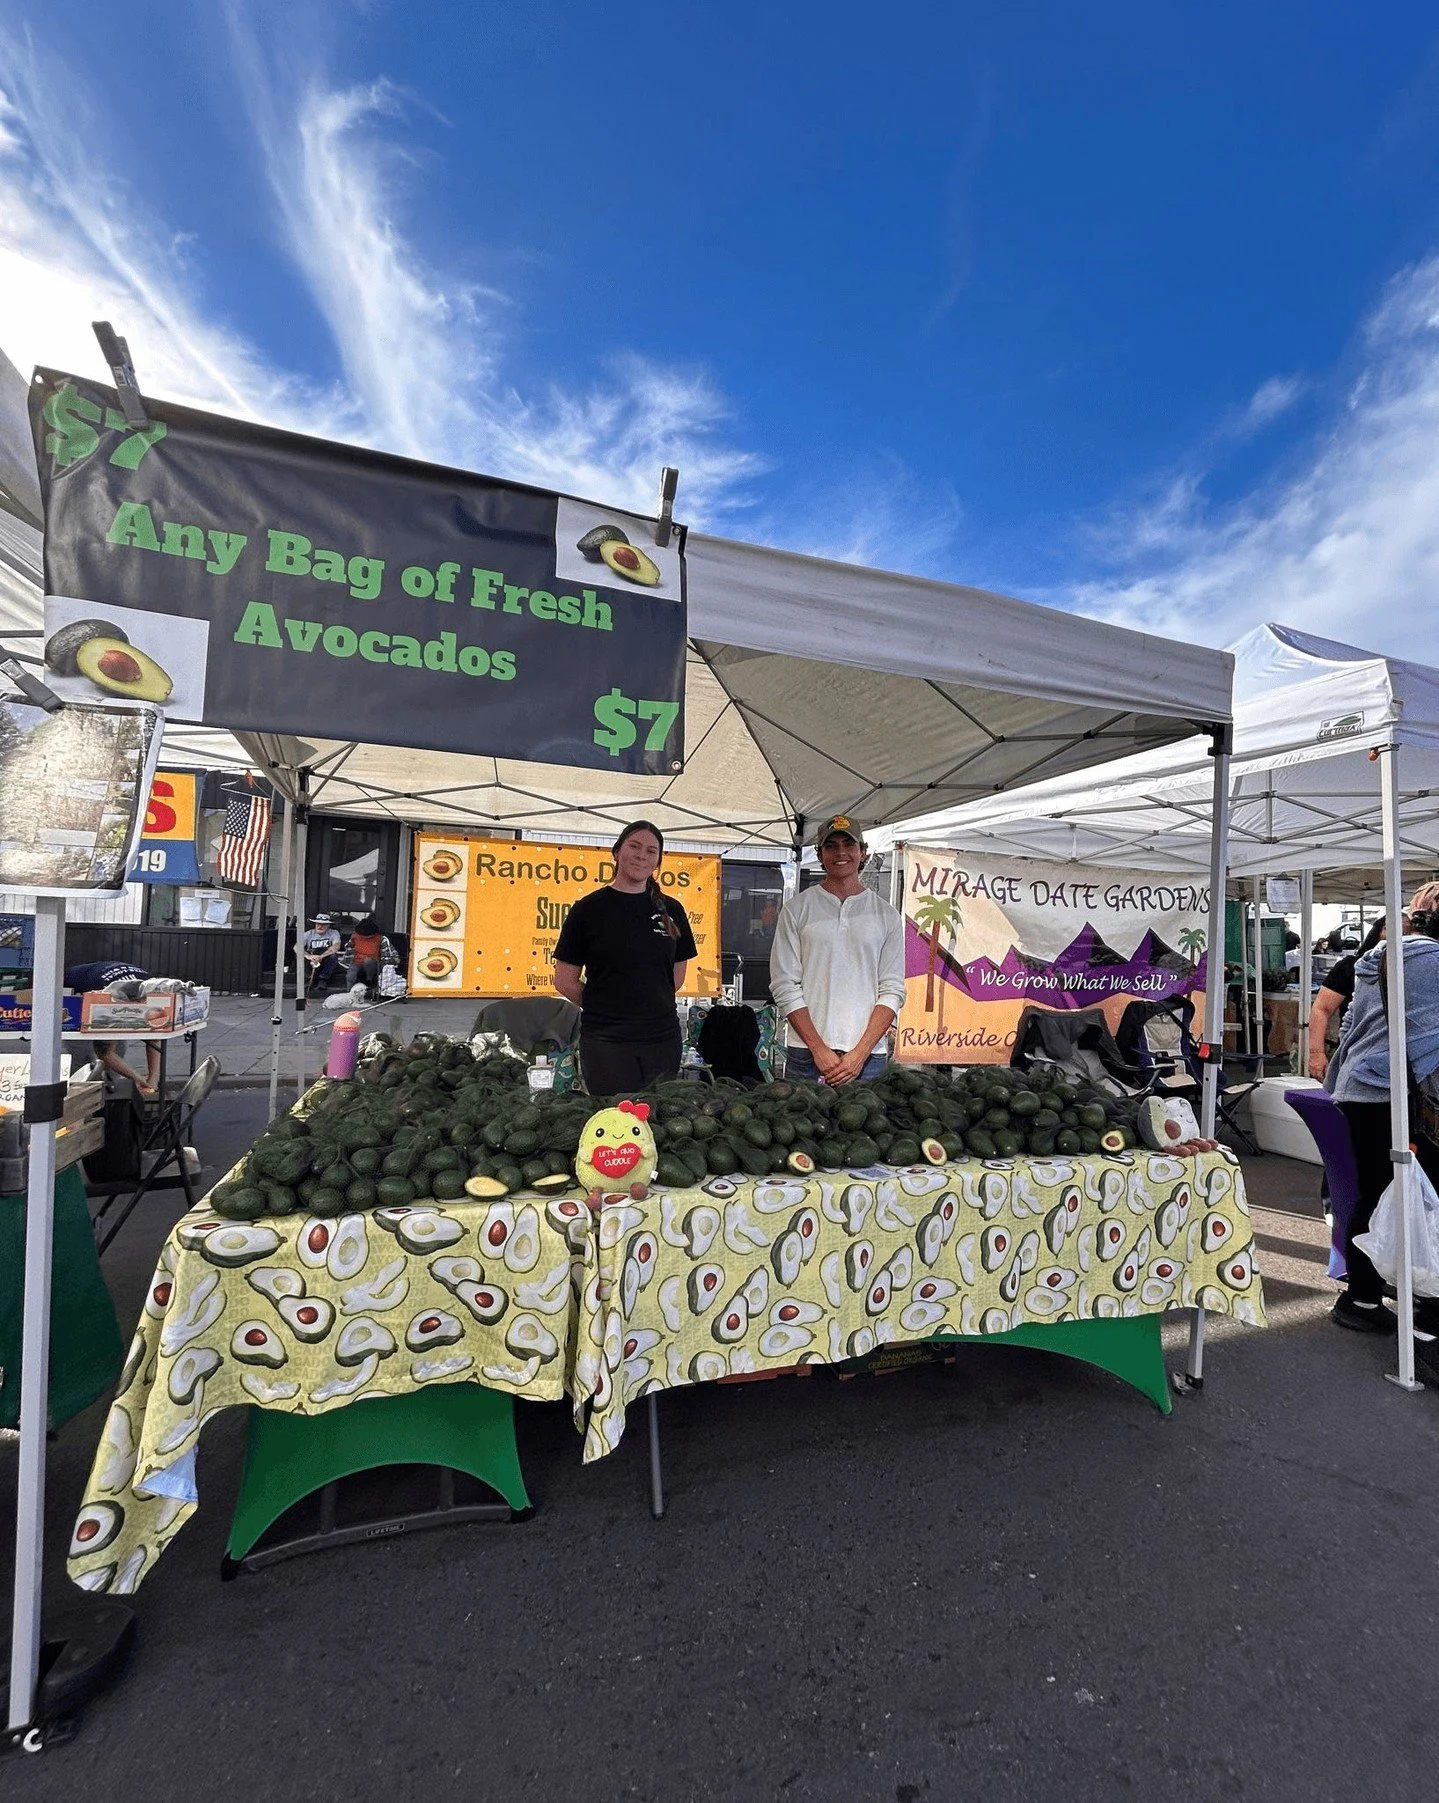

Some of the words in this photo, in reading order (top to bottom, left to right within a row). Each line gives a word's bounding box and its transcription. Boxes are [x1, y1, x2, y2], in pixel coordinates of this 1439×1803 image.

[43, 382, 167, 470] $7
[105, 500, 247, 575] Any
[265, 529, 385, 600] Bag
[401, 562, 461, 603] of
[470, 567, 614, 631] Fresh
[234, 601, 517, 681] Avocados
[593, 688, 680, 757] $7
[132, 849, 167, 872] 19
[476, 853, 588, 882] Rancho
[911, 862, 1022, 905] MIRAGE
[1030, 881, 1100, 909] DATE
[1103, 883, 1211, 914] GARDENS
[526, 973, 548, 986] Where
[1012, 971, 1058, 989] Grow
[1063, 973, 1109, 990] What
[1110, 975, 1132, 989] We
[1132, 975, 1167, 991] Sell
[901, 1027, 1000, 1049] Riverside
